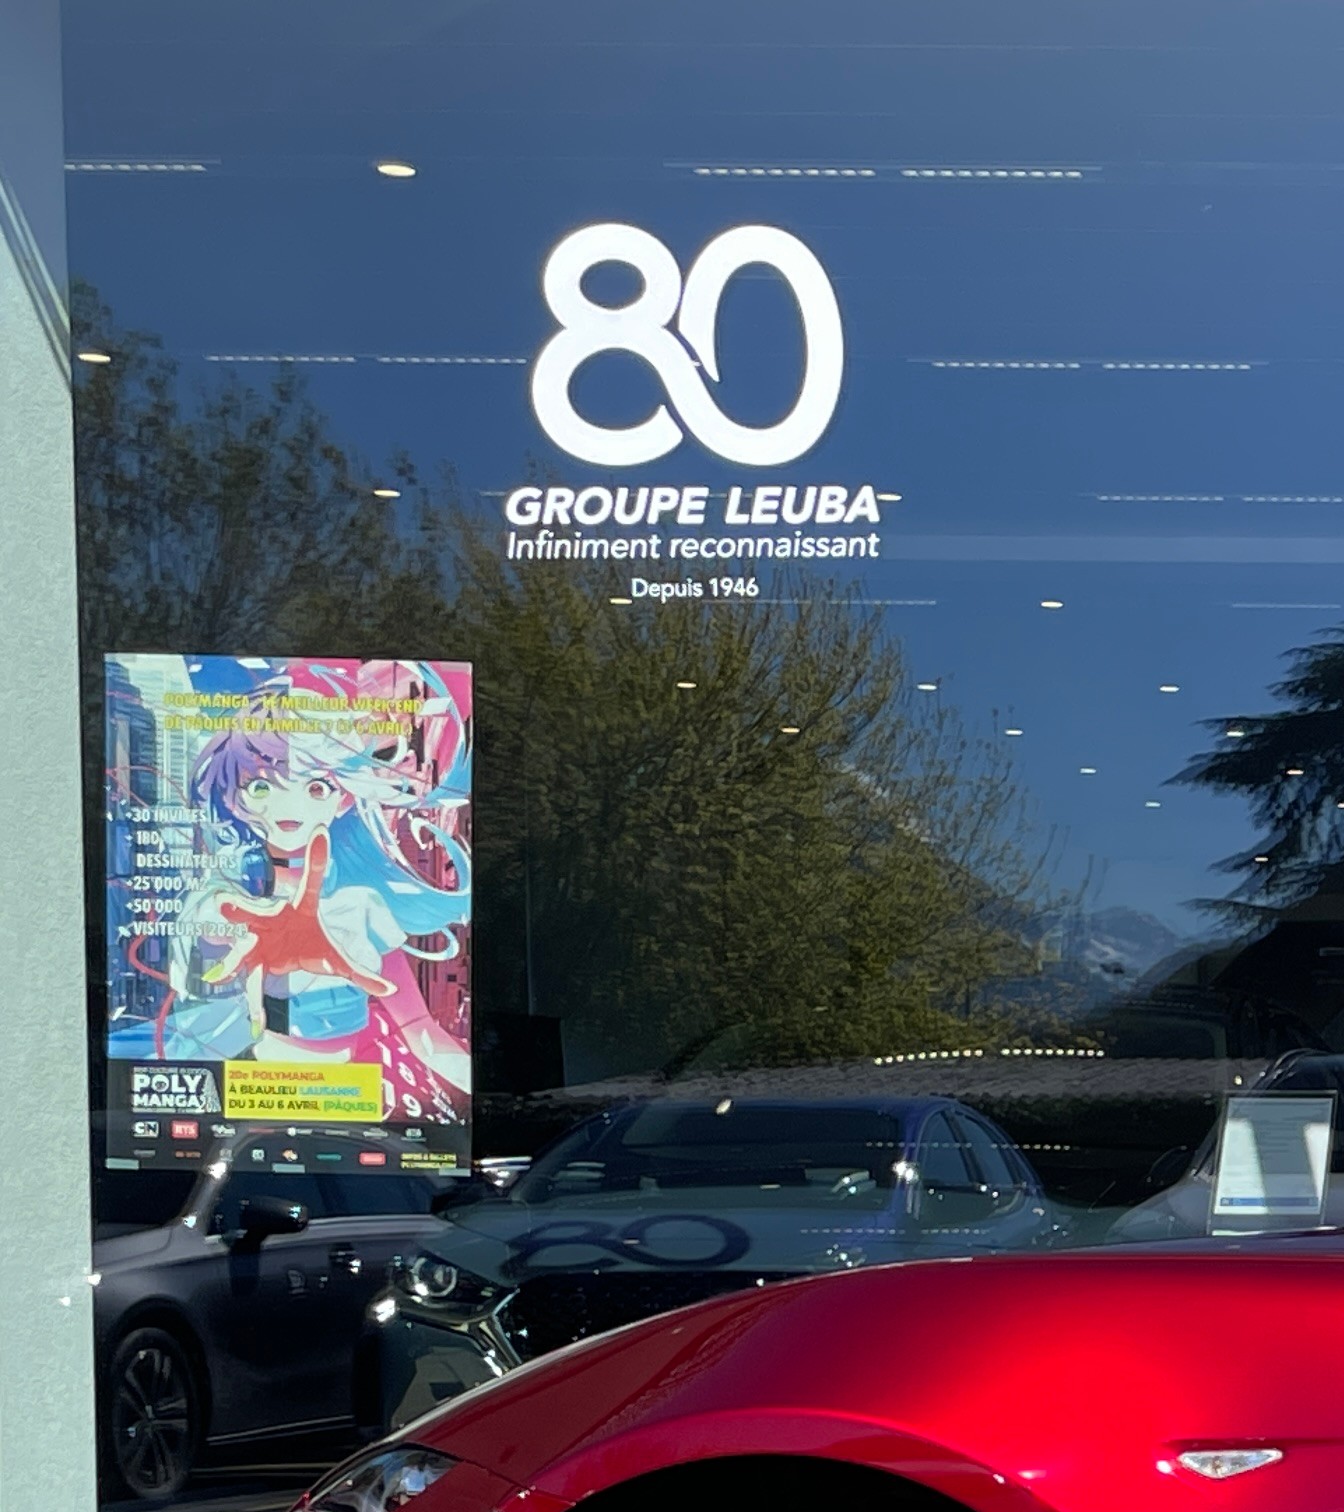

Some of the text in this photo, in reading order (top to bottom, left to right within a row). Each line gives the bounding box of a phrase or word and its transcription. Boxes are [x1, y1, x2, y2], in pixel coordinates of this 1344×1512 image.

[532, 223, 844, 466] 80
[505, 485, 881, 525] GROUPE LEUBA
[507, 530, 880, 560] Infiniment reconnaissant
[631, 577, 759, 602] Depuis 1946
[136, 853, 238, 869] DESSINATEURS
[133, 921, 203, 937] VISITEURS
[132, 1074, 202, 1093] POLY
[252, 1070, 325, 1081] POLYMANGA
[132, 1093, 201, 1108] MANGA
[228, 1099, 246, 1109] DU
[258, 1100, 275, 1110] AU
